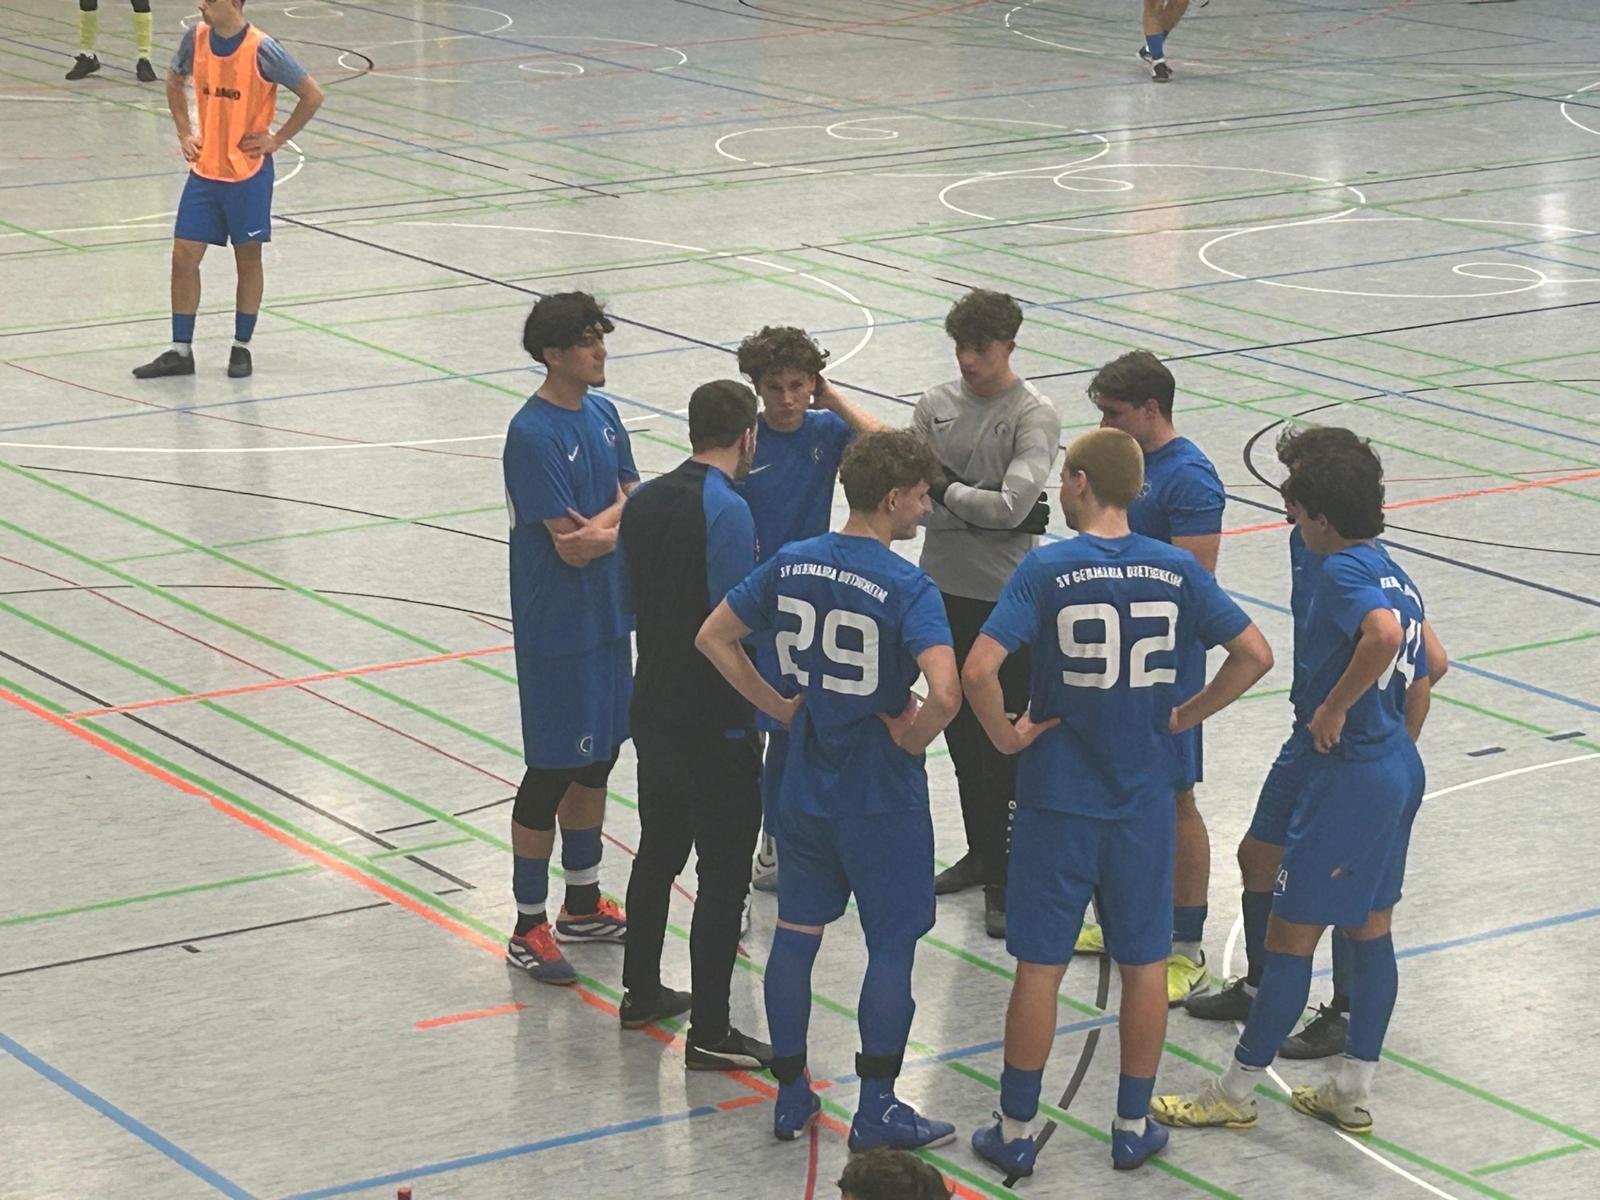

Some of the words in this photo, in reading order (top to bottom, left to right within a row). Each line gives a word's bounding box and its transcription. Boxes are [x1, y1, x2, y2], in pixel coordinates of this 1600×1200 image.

[780, 565, 792, 578] SV
[1056, 573, 1070, 589] SV
[775, 594, 880, 697] 29
[1056, 601, 1179, 690] 92
